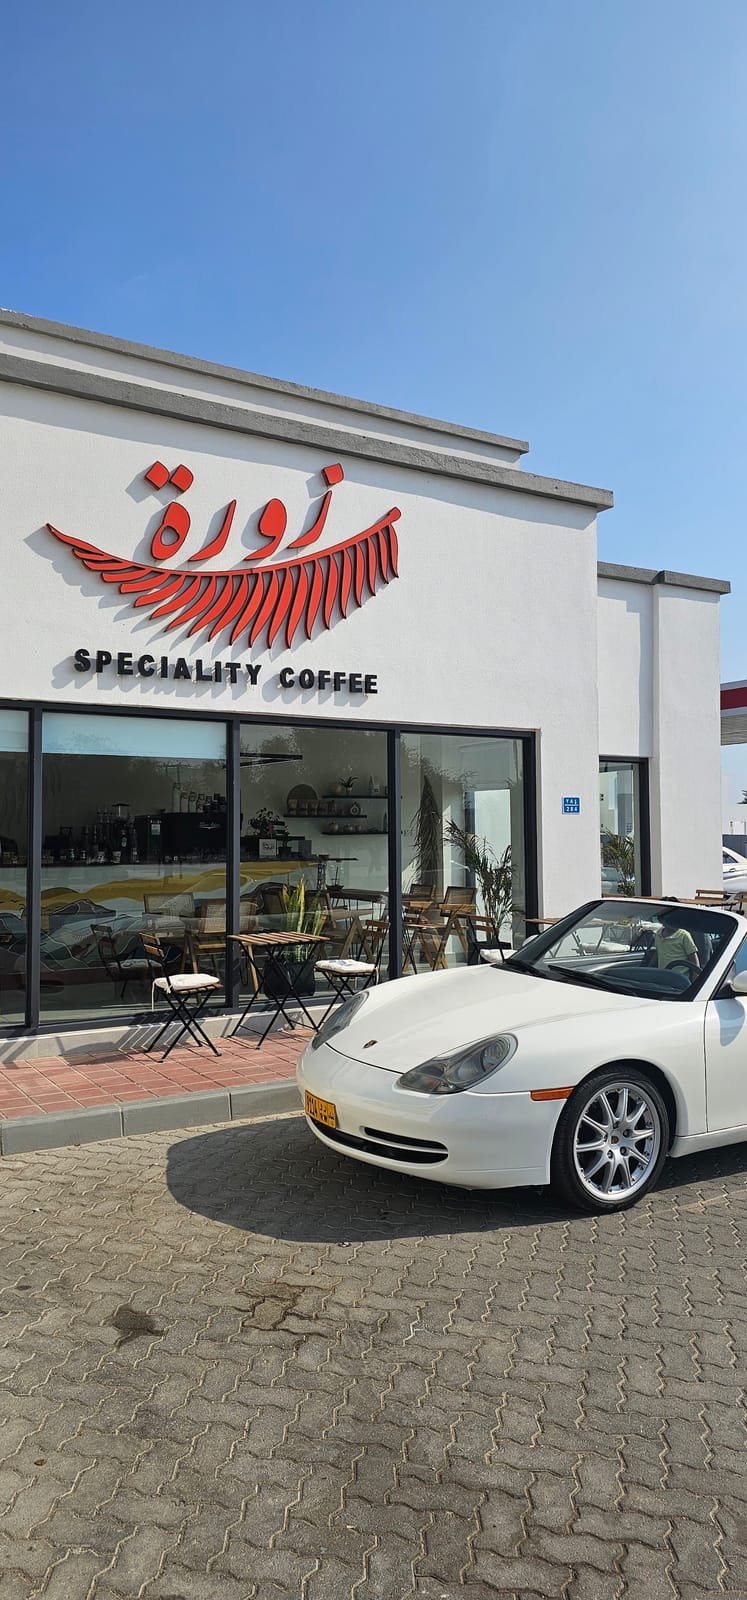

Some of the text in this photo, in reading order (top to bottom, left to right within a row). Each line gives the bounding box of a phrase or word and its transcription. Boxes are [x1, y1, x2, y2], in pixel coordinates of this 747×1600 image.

[145, 461, 345, 563] زورة
[74, 648, 379, 695] SPECIALITY COFFEE
